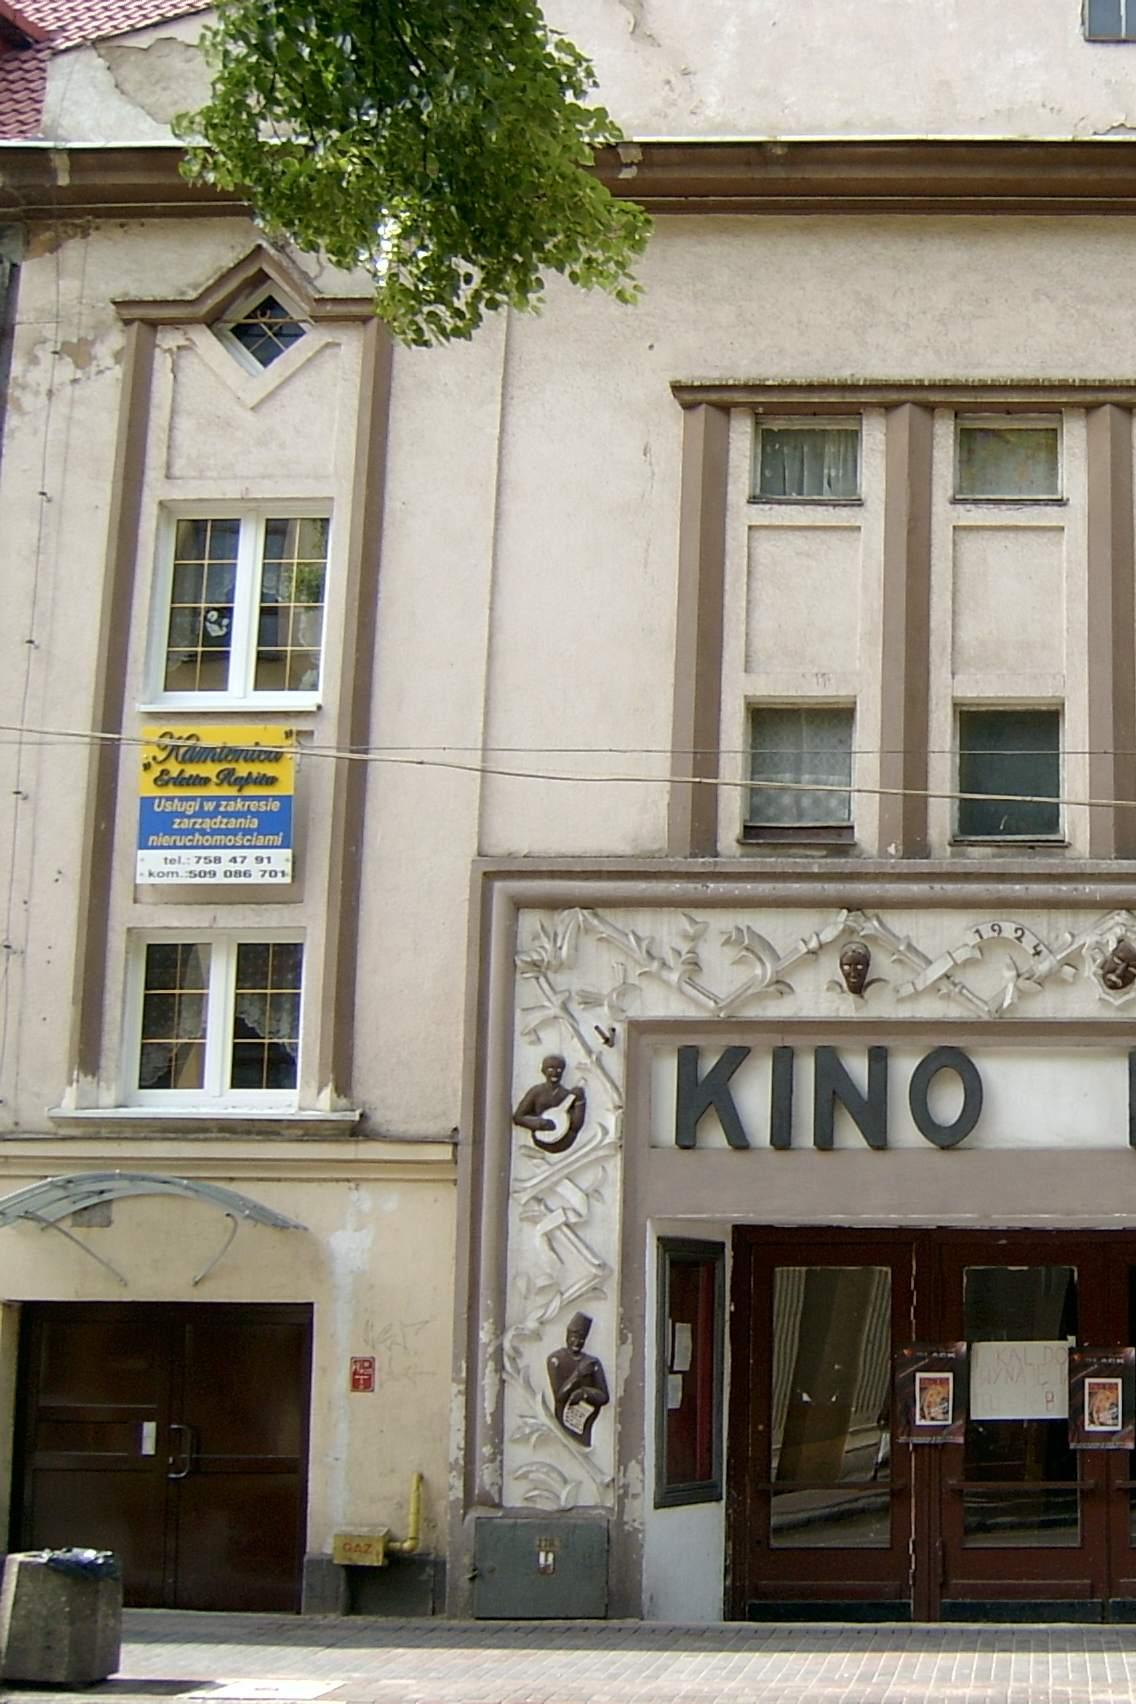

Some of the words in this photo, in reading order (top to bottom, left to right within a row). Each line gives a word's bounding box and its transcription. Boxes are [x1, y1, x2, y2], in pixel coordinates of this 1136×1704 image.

[153, 798, 200, 814] Usługi
[203, 801, 215, 811] w
[219, 798, 281, 811] zakresie
[172, 816, 259, 832] zarządzania
[148, 832, 283, 846] nieruchomościami
[194, 856, 222, 865] 758
[229, 856, 248, 865] 47
[254, 856, 272, 865] 91
[223, 869, 252, 879] 086
[259, 869, 286, 879] 701
[973, 923, 1042, 957] 1924
[674, 1045, 984, 1150] KINO
[342, 1541, 373, 1554] GAZ
